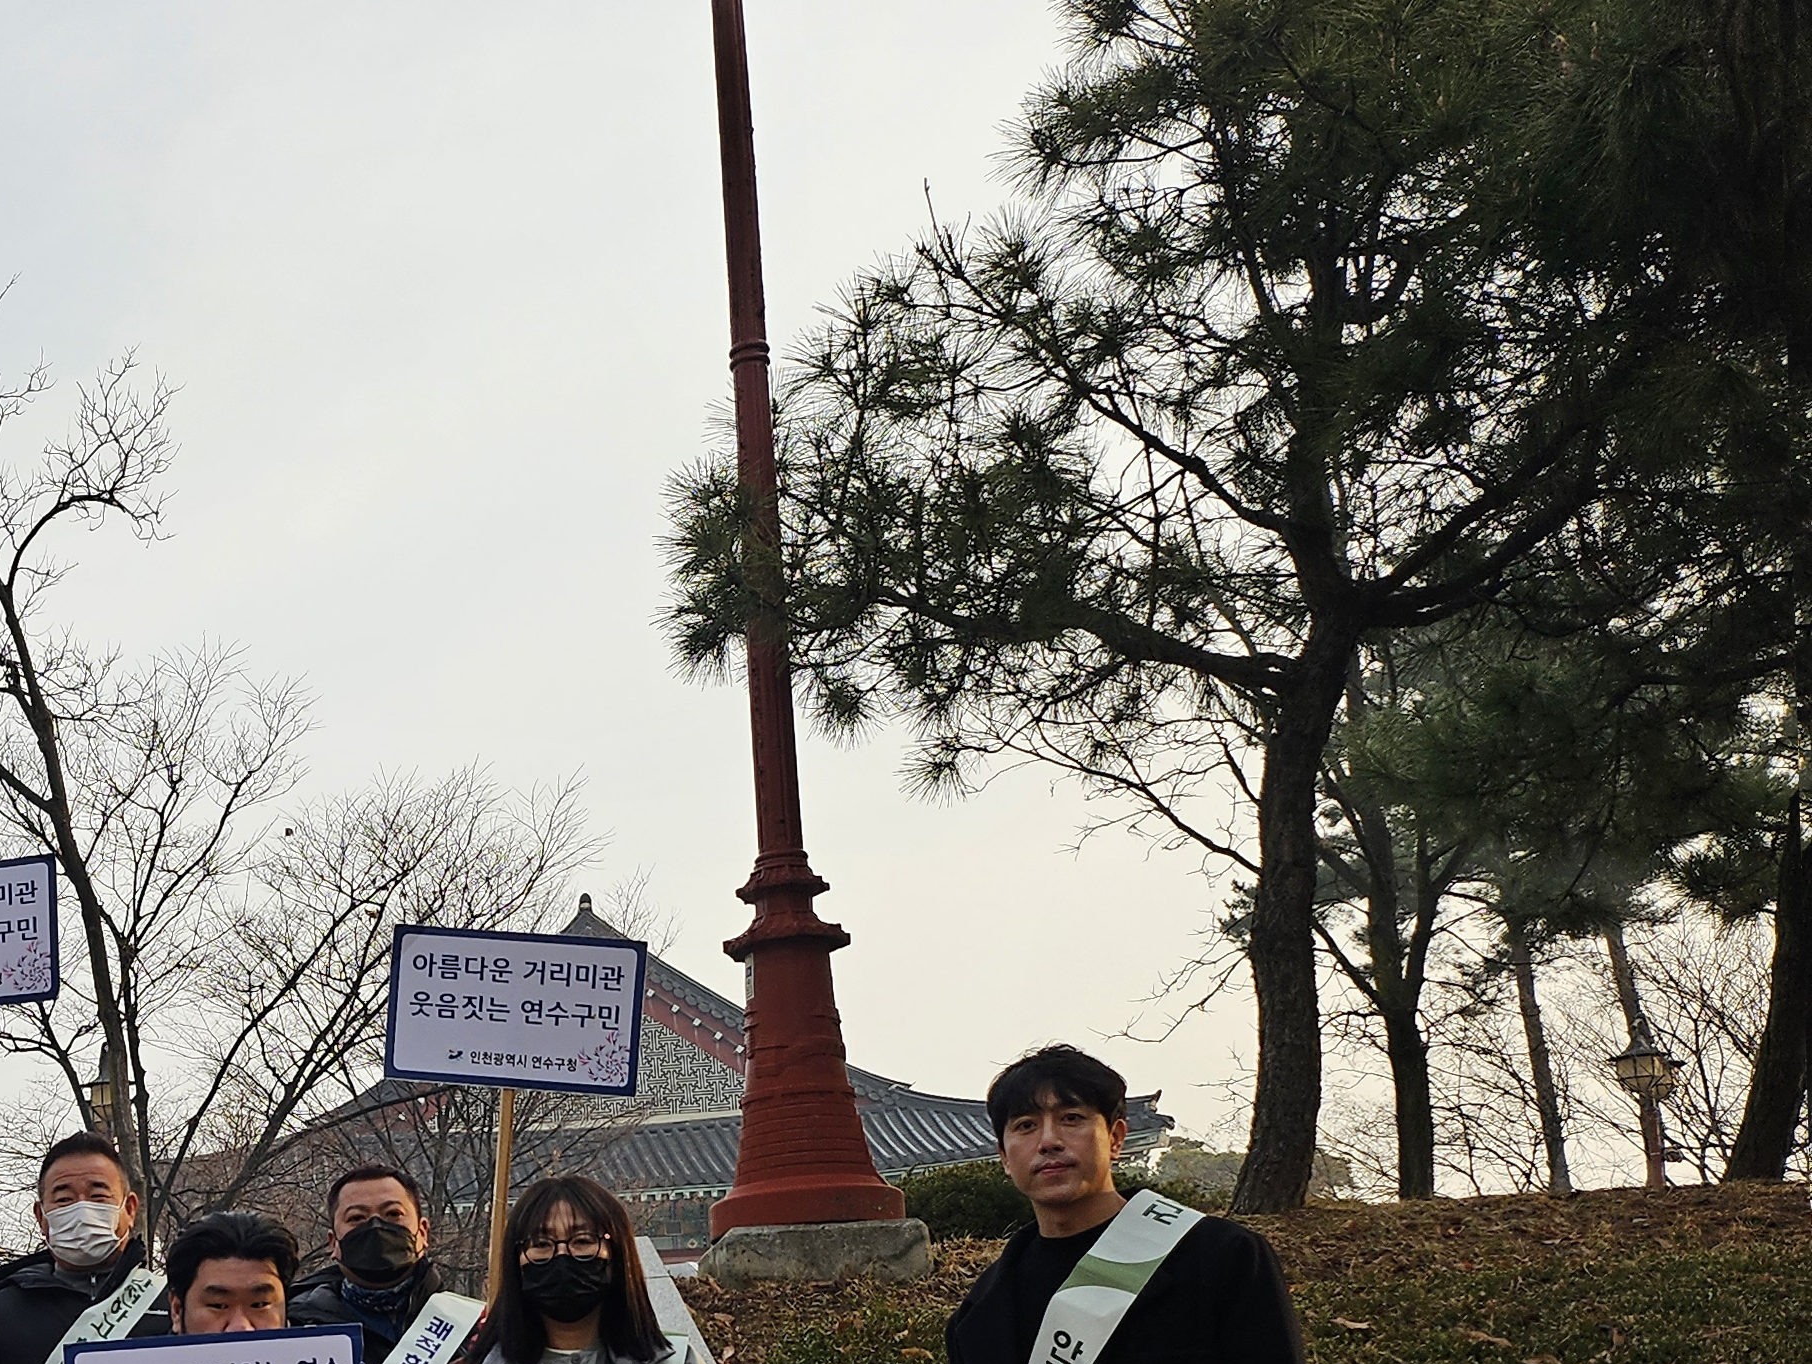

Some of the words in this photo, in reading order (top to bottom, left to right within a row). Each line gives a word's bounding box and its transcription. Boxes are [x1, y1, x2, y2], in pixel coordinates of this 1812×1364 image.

[412, 952, 513, 984] 아름다운
[523, 960, 625, 992] 거리미관
[409, 990, 511, 1023] 웃음짓는
[520, 999, 621, 1031] 연수구민
[470, 1050, 528, 1068] 인천광역시
[531, 1055, 577, 1072] 연수구청
